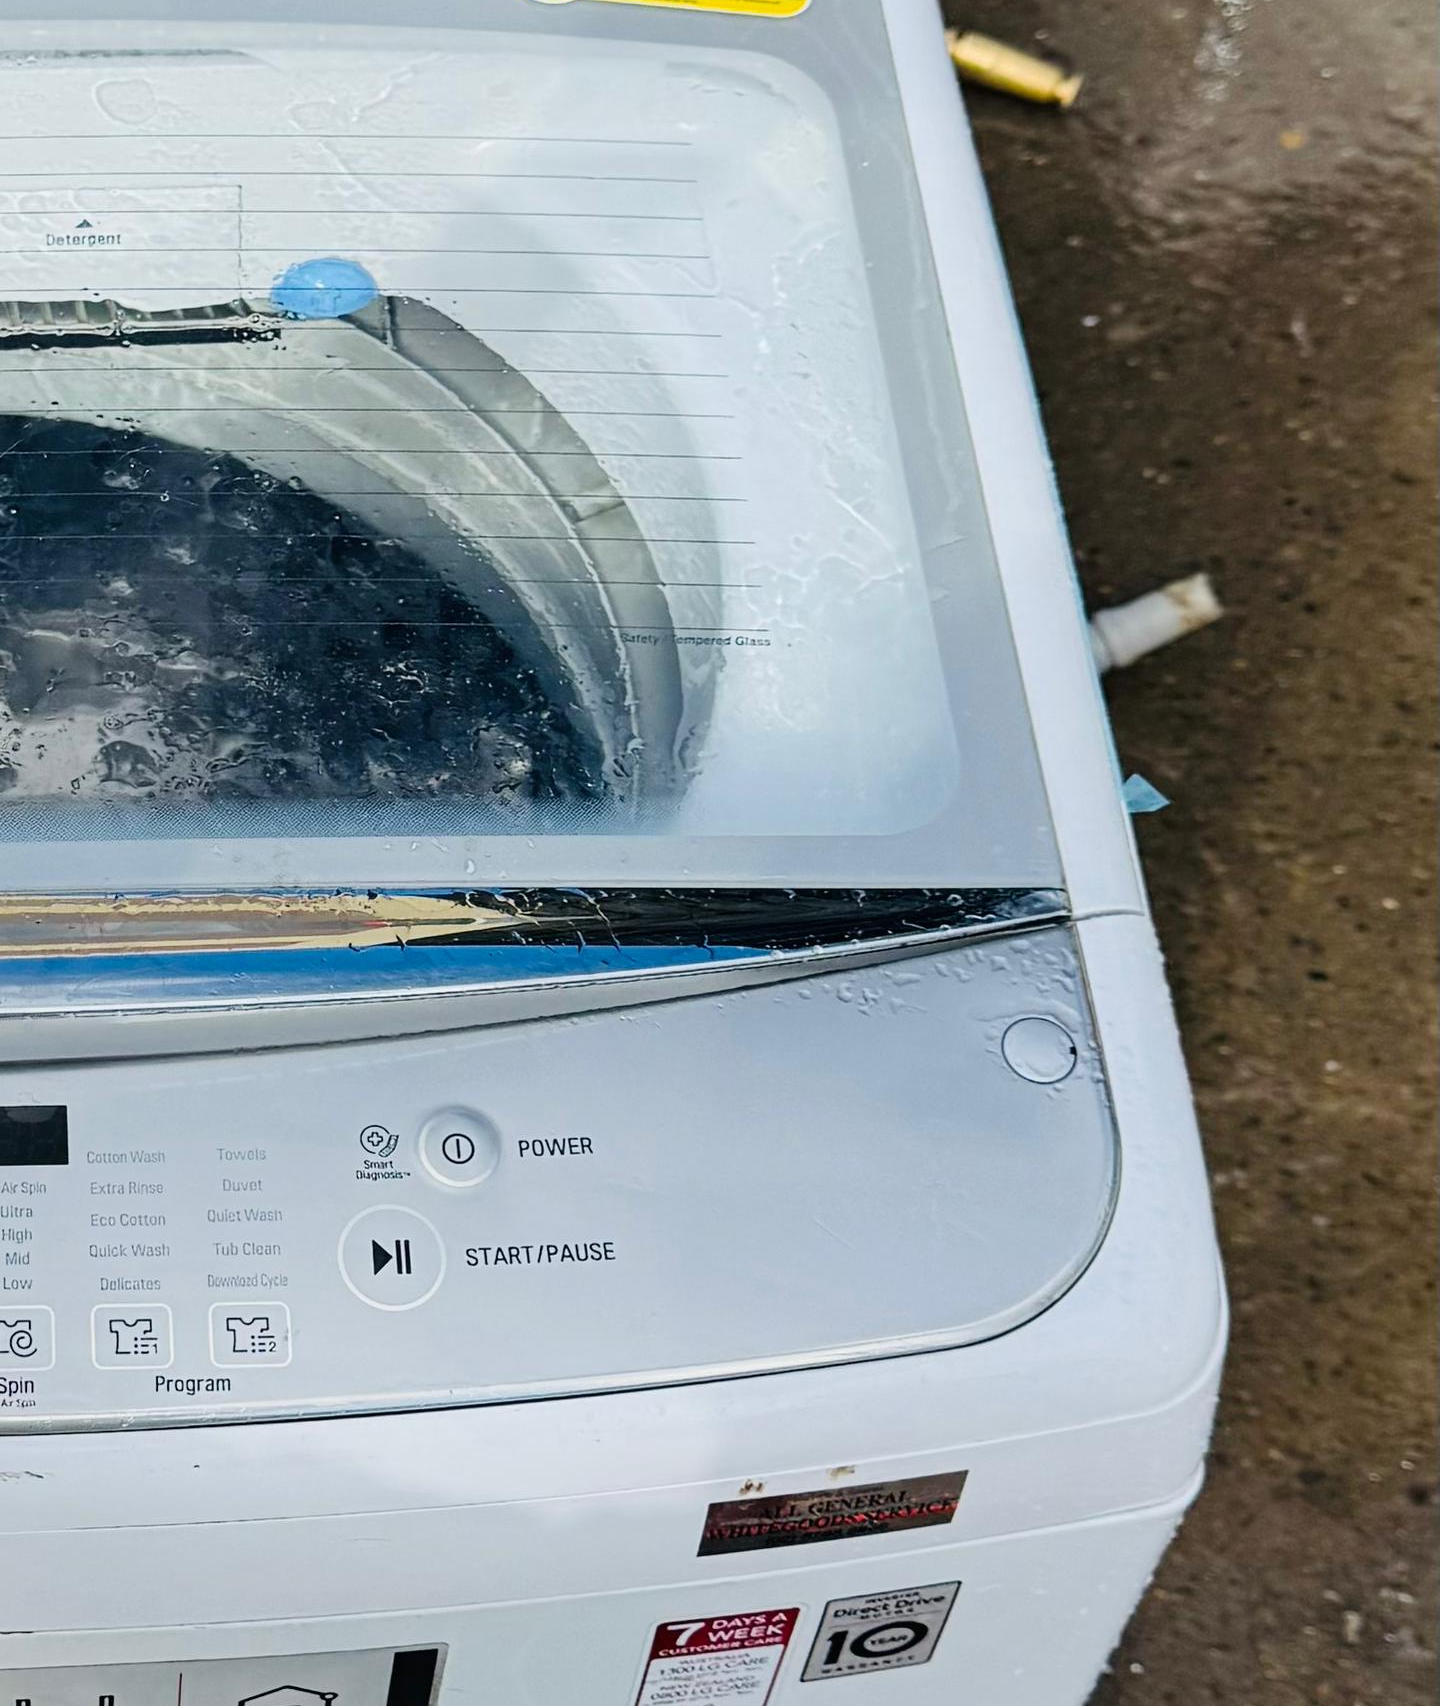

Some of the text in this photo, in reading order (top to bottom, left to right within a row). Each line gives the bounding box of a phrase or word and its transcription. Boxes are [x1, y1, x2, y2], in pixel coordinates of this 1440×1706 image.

[46, 234, 121, 247] Detergent
[216, 1147, 267, 1162] Towels
[518, 1137, 594, 1158] POWER
[87, 1150, 165, 1165] Cotton Wash
[363, 1159, 394, 1170] Smart
[20, 1181, 47, 1196] Spin
[90, 1180, 164, 1195] Extra Rinse
[222, 1178, 263, 1192] Duvet
[90, 1212, 166, 1227] Eco Cotton
[207, 1208, 283, 1224] Quiet Wash
[2, 1228, 33, 1243] High
[89, 1244, 170, 1259] Quick Wash
[213, 1242, 281, 1256] Tub Clean
[465, 1242, 616, 1267] START/PAUSE
[5, 1252, 30, 1266] Mid
[2, 1276, 33, 1290] Low
[100, 1276, 161, 1291] Delicates
[155, 1375, 231, 1396] Program
[833, 1595, 945, 1618] Direct Drive
[667, 1612, 787, 1646] 7 DAYS A
[708, 1624, 785, 1642] WEEK
[659, 1636, 783, 1656] CUSTOMER CARE
[824, 1621, 929, 1665] 10
